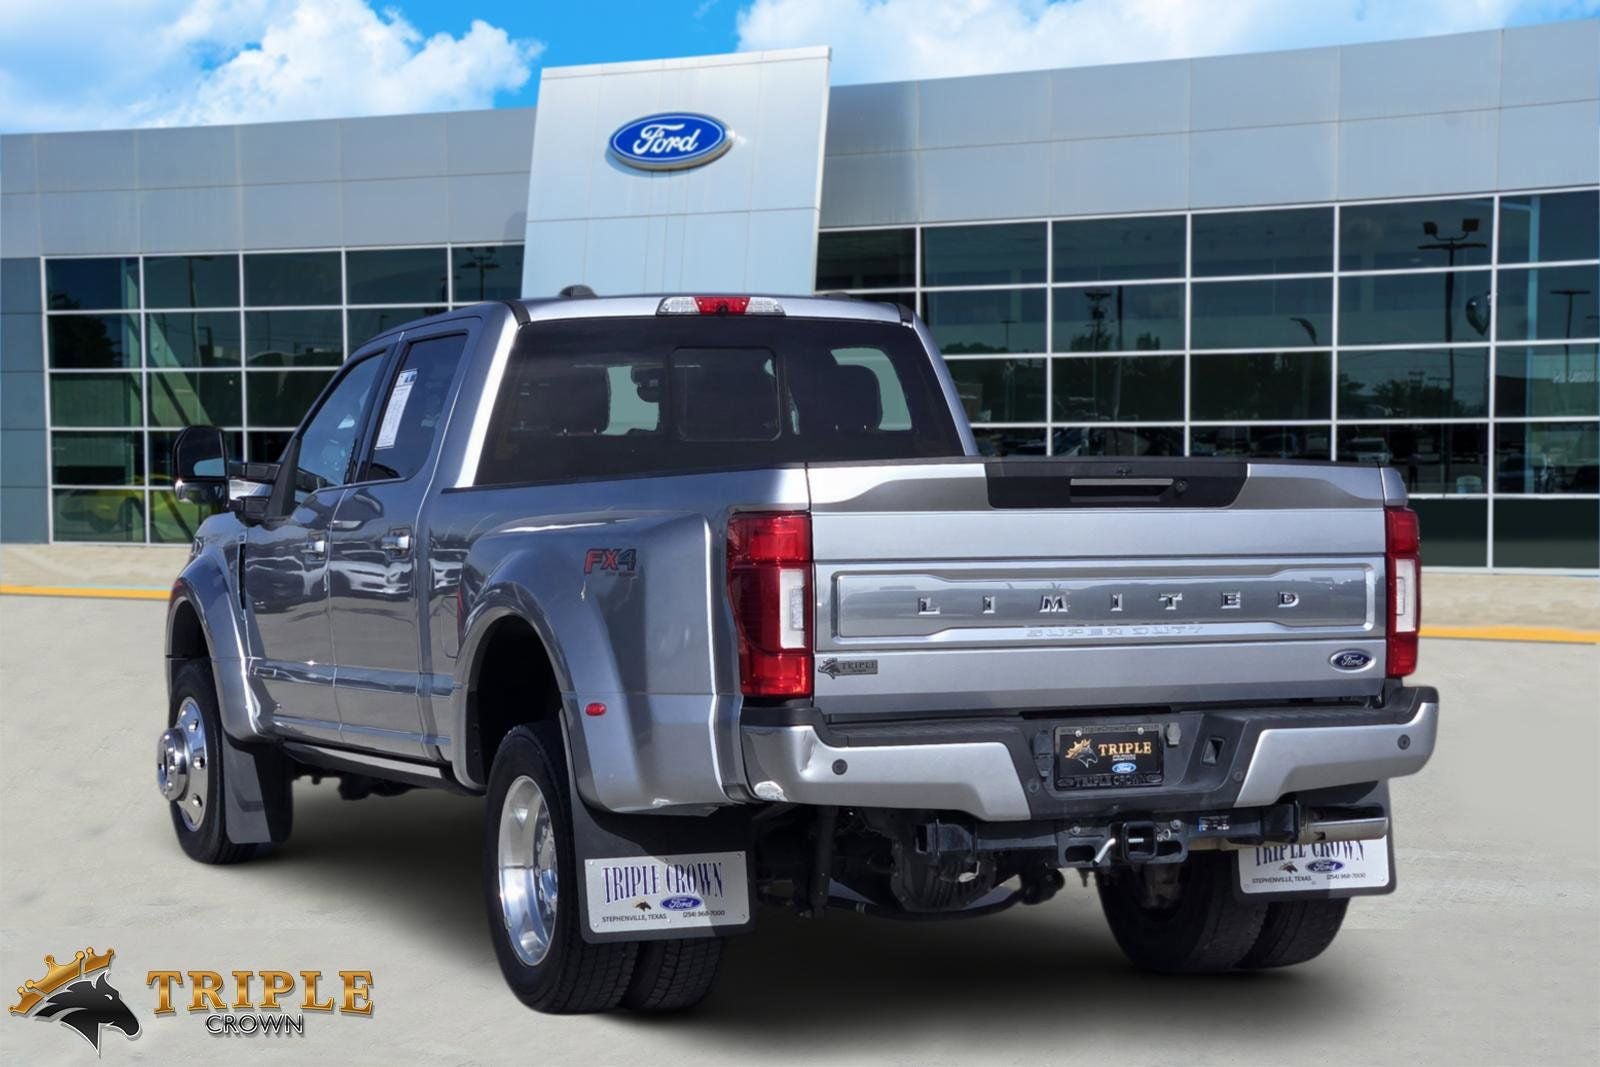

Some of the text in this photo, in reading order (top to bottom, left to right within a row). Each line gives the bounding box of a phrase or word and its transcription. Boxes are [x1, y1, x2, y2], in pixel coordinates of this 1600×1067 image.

[632, 123, 701, 155] Ford
[584, 548, 637, 576] FX4
[918, 591, 1299, 615] LIMITED
[1026, 624, 1204, 638] SUPER DUTY
[1098, 741, 1152, 757] TRIPLE
[602, 862, 723, 903] TRIPLE CROWN
[668, 899, 694, 909] Ford
[602, 914, 648, 923] STEPHENVILLE,
